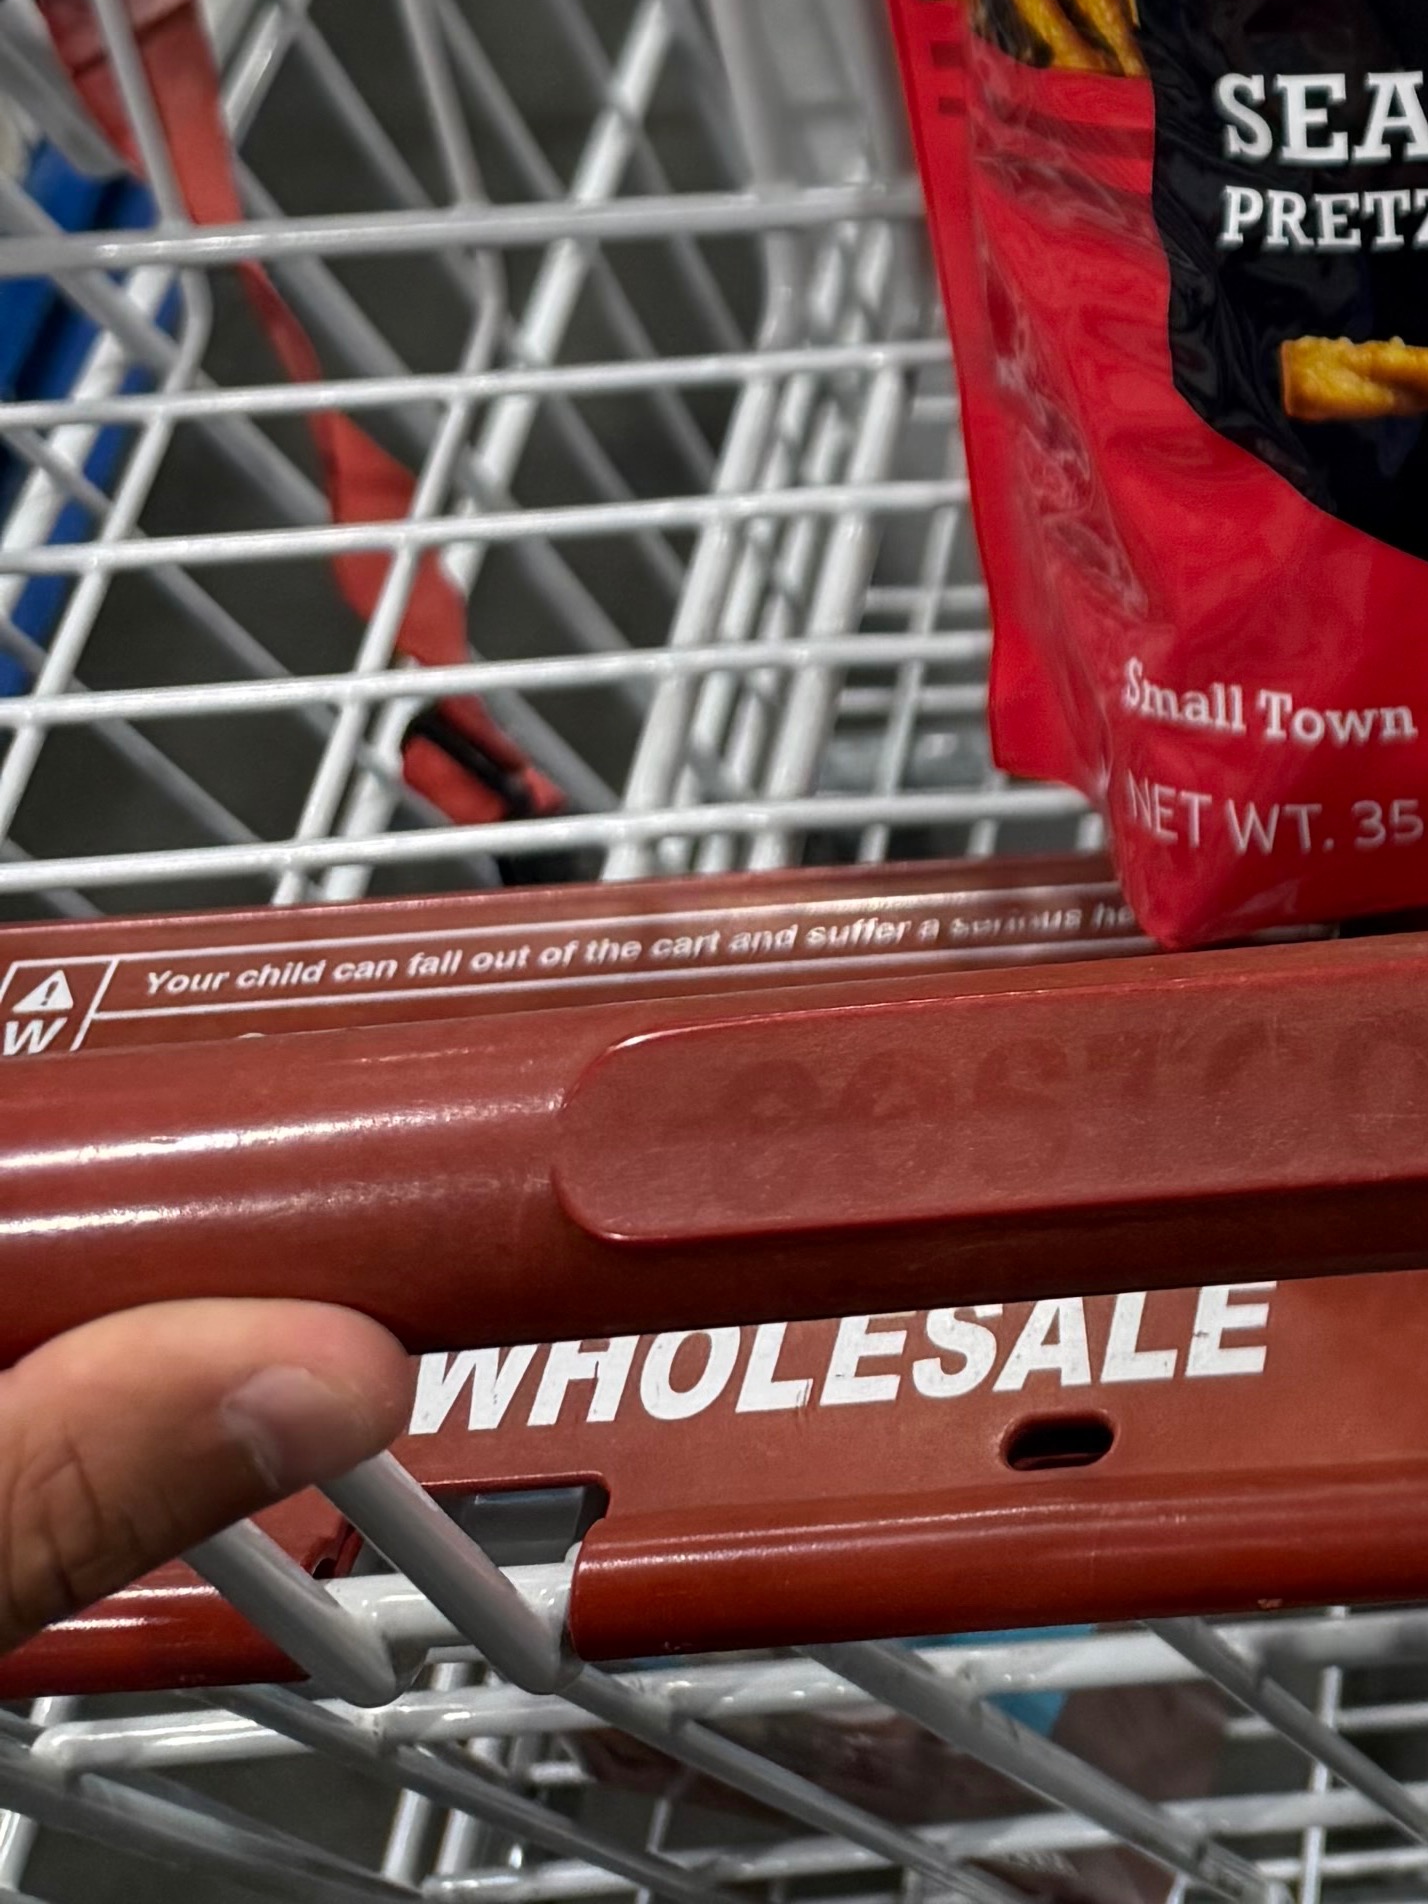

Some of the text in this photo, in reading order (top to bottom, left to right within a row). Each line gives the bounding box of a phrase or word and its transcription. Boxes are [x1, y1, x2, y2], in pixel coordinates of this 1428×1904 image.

[1123, 657, 1246, 735] Small
[1256, 690, 1413, 744] Town
[1128, 769, 1213, 848] NET
[1225, 798, 1335, 855] WT.
[1352, 800, 1426, 848] 35
[145, 969, 227, 996] Your
[235, 958, 323, 991] child
[334, 957, 400, 983] can
[406, 950, 462, 982] fall
[470, 945, 530, 971] out
[538, 938, 581, 967] of
[585, 936, 643, 964] the
[649, 928, 721, 963] cart
[728, 923, 799, 956] and
[805, 916, 909, 949] suffer
[918, 915, 941, 940] a
[1092, 900, 1134, 929] he
[408, 1280, 1277, 1435] WHOLESALE
